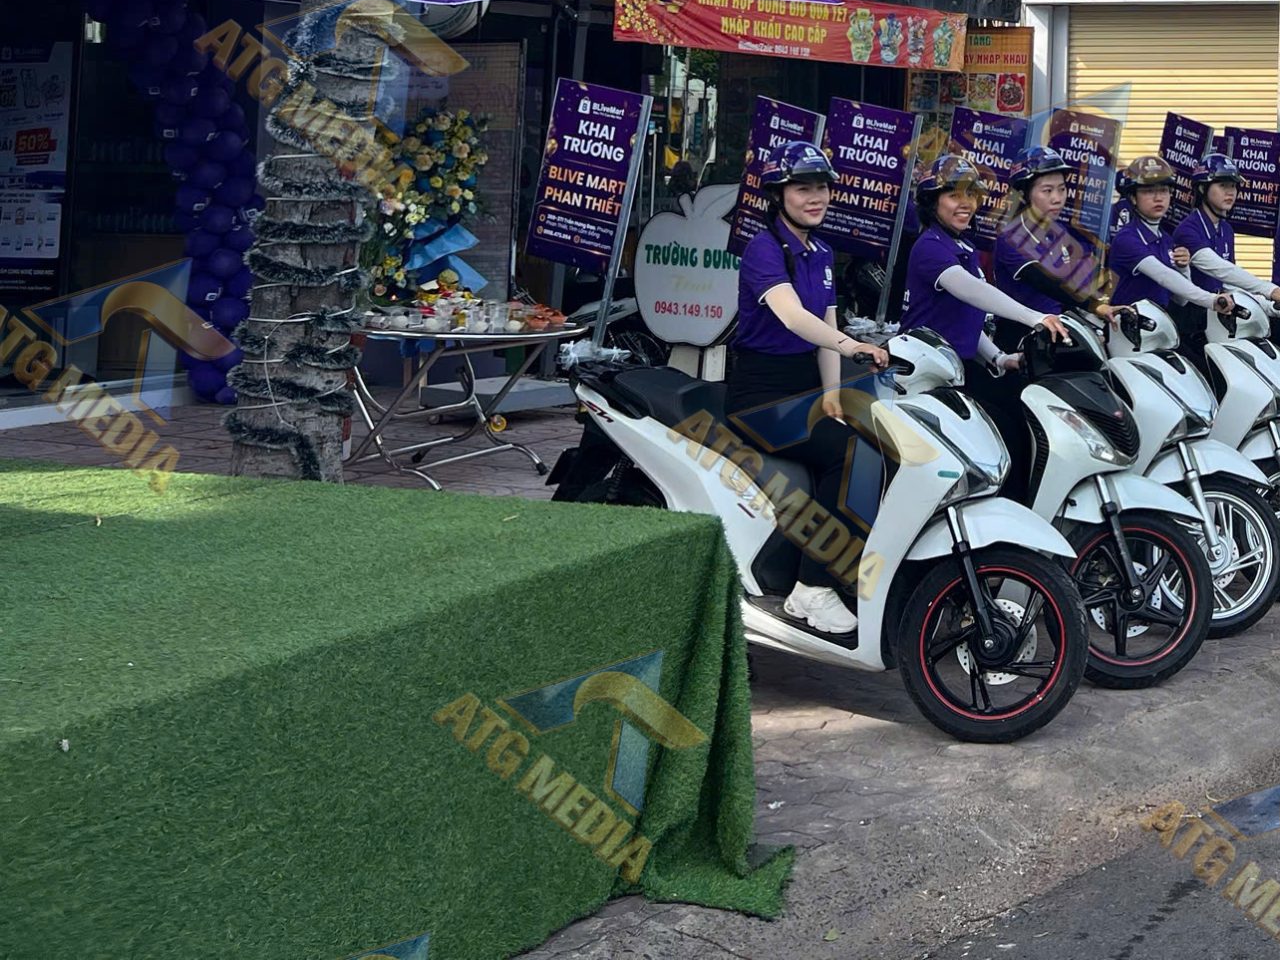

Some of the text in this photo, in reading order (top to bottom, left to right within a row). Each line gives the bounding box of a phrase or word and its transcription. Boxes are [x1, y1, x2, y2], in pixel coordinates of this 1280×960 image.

[721, 15, 750, 39] NHẬP
[784, 24, 805, 41] CAO
[807, 21, 828, 44] CẤP
[578, 120, 616, 141] KHAI
[563, 135, 625, 162] TRƯƠNG
[853, 133, 889, 152] KHAI
[973, 138, 1005, 154] KHAI
[1070, 137, 1098, 153] KHAI
[1174, 139, 1195, 154] KHAI
[838, 145, 898, 169] TRƯƠNG
[960, 149, 1013, 170] TRƯƠNG
[1058, 147, 1106, 167] TRƯƠNG
[1242, 148, 1268, 162] KHAI
[549, 165, 626, 195] BLIVE MART
[746, 174, 761, 190] BLI
[833, 172, 901, 196] LIVE MART
[1078, 175, 1108, 190] MART
[1252, 181, 1280, 193] MART
[544, 186, 622, 217] PHAN THIẾT
[830, 190, 898, 214] HAN THIẾT
[981, 191, 1013, 211] THIẾT
[645, 241, 741, 271] TRƯỜNG DUNG
[654, 301, 723, 319] 0943.149.150
